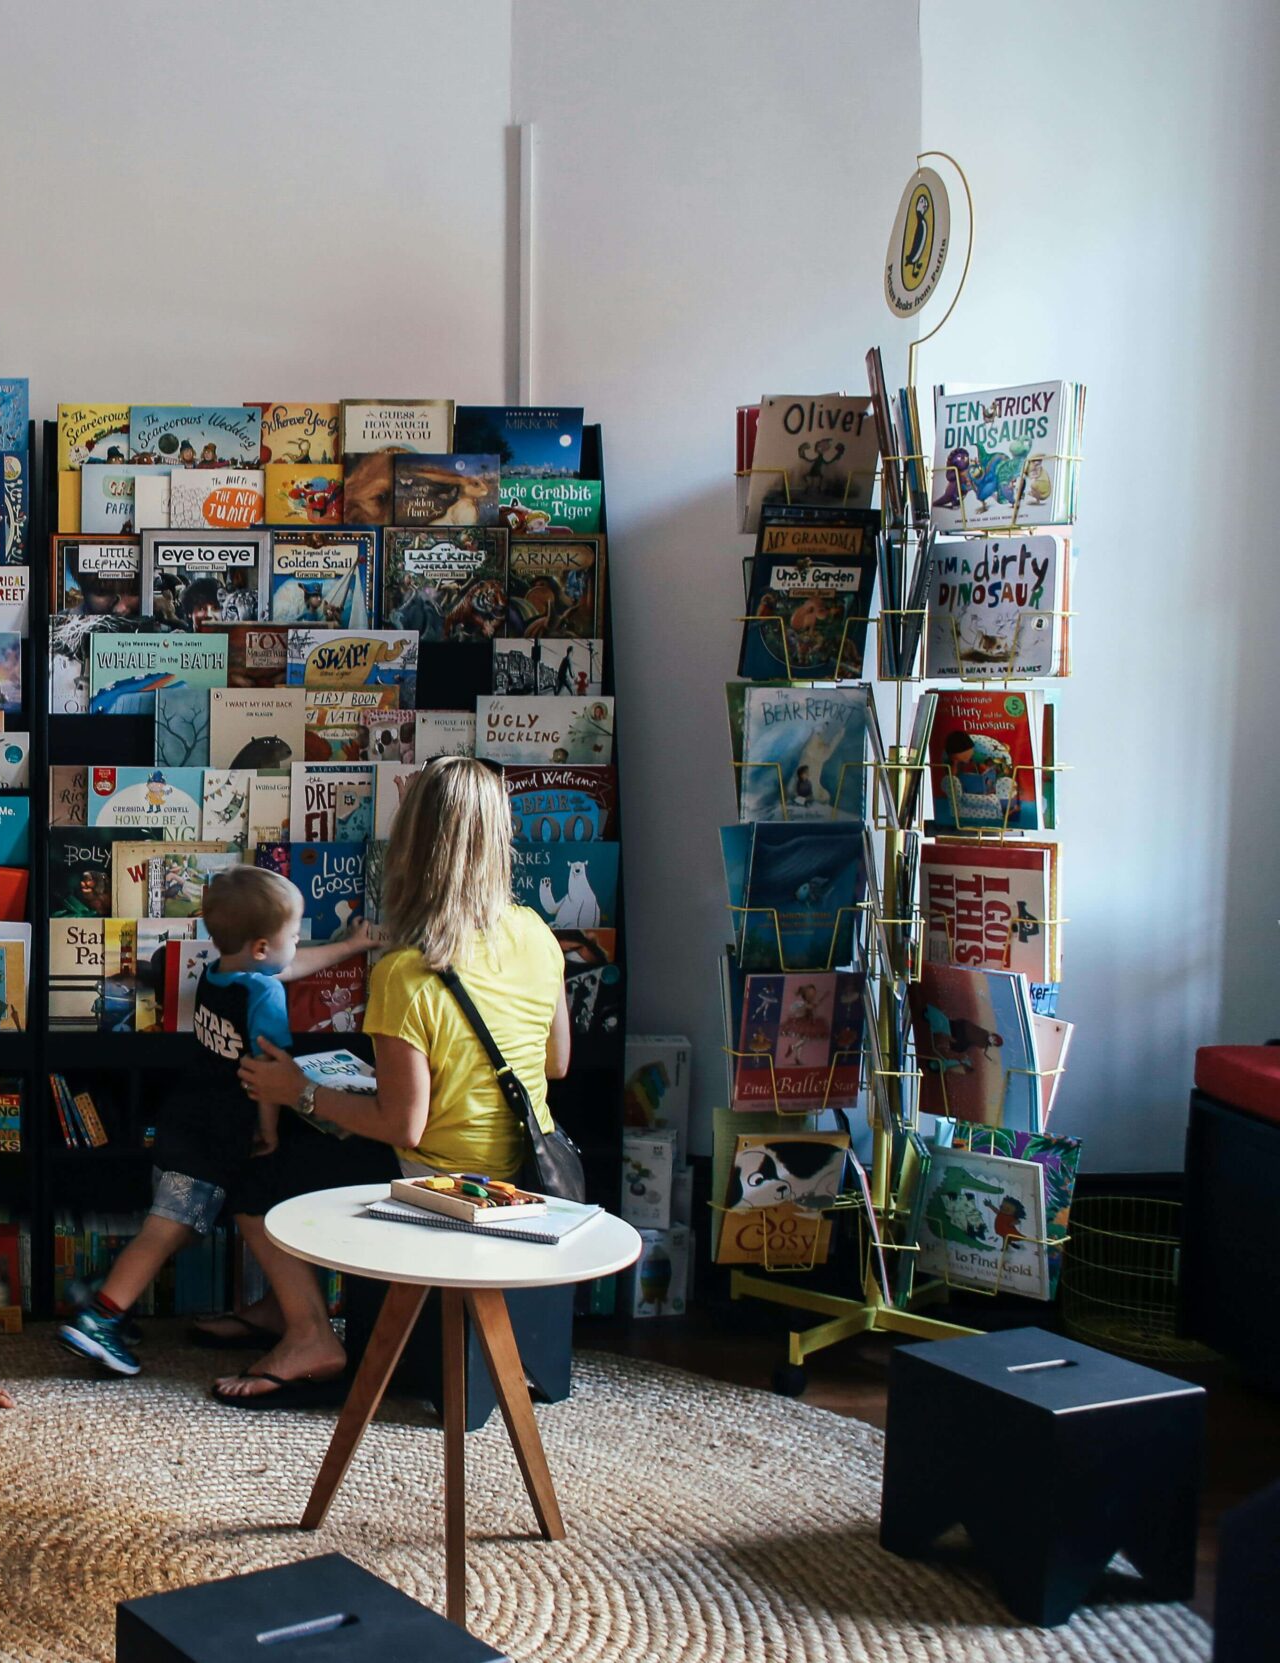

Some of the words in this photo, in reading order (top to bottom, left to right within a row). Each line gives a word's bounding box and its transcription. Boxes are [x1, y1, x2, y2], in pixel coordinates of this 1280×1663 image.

[895, 295, 913, 311] Books
[379, 411, 415, 420] GUESS
[945, 401, 979, 425] TEN
[994, 391, 1055, 420] TRICKY
[144, 414, 159, 427] The
[364, 421, 393, 430] HOW
[395, 421, 429, 430] MUCH
[504, 418, 558, 429] MIRROR
[783, 403, 869, 437] Oliver
[138, 414, 204, 449] Scarecrows'
[208, 412, 256, 450] Wedding
[362, 431, 368, 440] I
[371, 430, 403, 440] LOVE
[406, 430, 431, 440] YOU
[944, 416, 1049, 450] DINOSAURS
[215, 490, 232, 500] THE
[236, 491, 257, 506] NEW
[531, 484, 592, 500] Grabbit
[208, 503, 256, 524] JUMPER
[552, 501, 592, 519] Tiger
[768, 532, 788, 550] MY
[792, 530, 858, 552] GRANDMA
[162, 548, 195, 564] eye
[198, 549, 215, 561] to
[218, 550, 251, 564] eye
[277, 556, 319, 570] Golden
[322, 555, 353, 569] Snail
[408, 552, 442, 560] LAST
[444, 551, 484, 561] KING
[776, 568, 810, 583] Uno's
[811, 569, 855, 583] Garden
[974, 543, 1049, 592] dirty
[938, 581, 1043, 612] DINOSAUR
[96, 651, 158, 670] WHALE
[167, 656, 179, 664] the
[180, 652, 225, 669] BATH
[312, 642, 370, 670] SWAP!
[352, 692, 378, 706] BOOK
[762, 702, 802, 726] BEAR
[805, 697, 860, 721] REPORT
[950, 705, 982, 720] Harry
[487, 714, 539, 728] UGLY
[962, 718, 1015, 732] Dinosaurs
[486, 730, 560, 744] DUCKLING
[542, 771, 597, 788] Walliams
[523, 794, 570, 815] BEAR
[115, 814, 141, 825] HOW
[143, 814, 158, 825] TO
[162, 814, 177, 825] BE
[180, 815, 188, 825] A
[322, 852, 365, 878] LUCY
[312, 877, 365, 899] GOOSE
[984, 875, 1009, 894] I
[955, 874, 984, 965] THIS
[984, 900, 1012, 968] GOT
[196, 1004, 242, 1041] STAR
[194, 1020, 243, 1060] WARS
